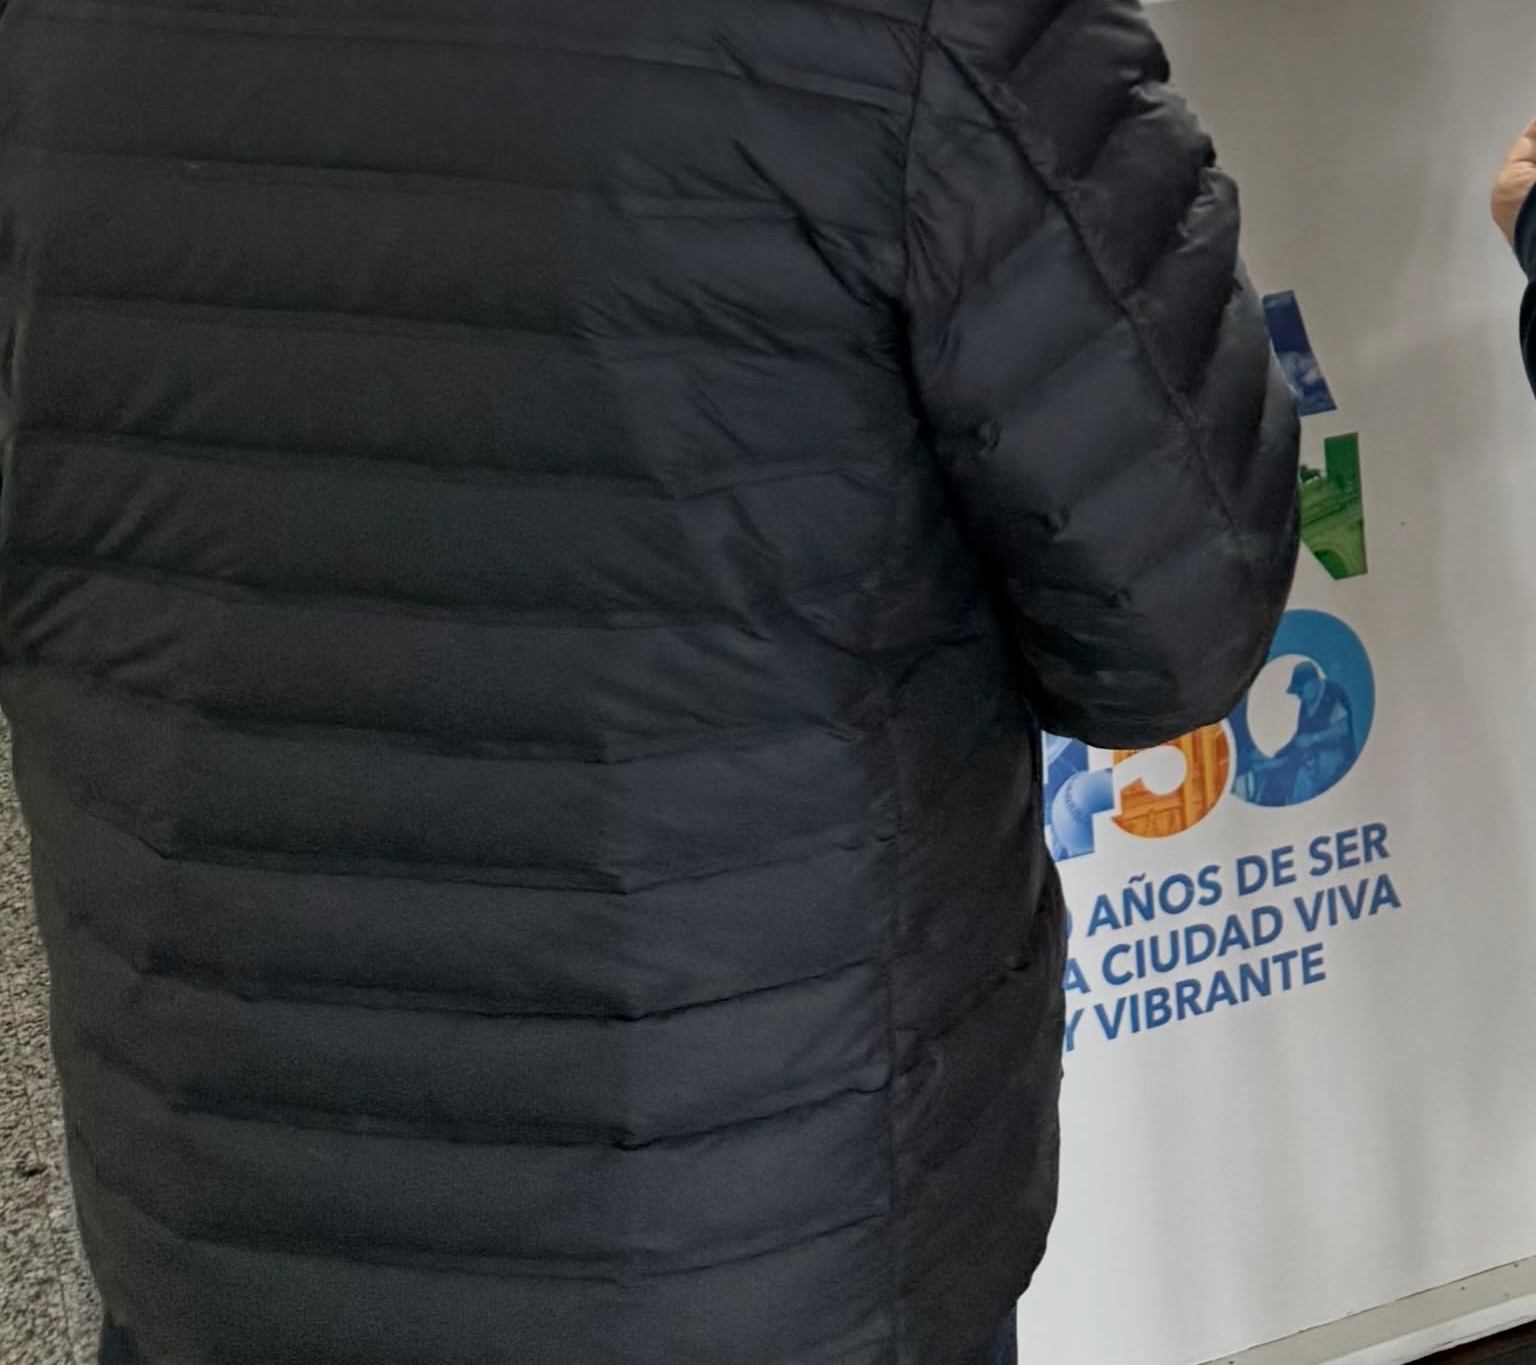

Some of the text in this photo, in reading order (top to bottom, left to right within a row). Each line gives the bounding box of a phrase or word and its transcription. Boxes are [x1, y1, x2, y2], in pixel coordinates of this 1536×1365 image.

[1086, 863, 1223, 937] AÑOS
[1236, 845, 1298, 897] DE
[1308, 822, 1391, 877] SER
[1101, 905, 1284, 986] CIUDAD
[1293, 873, 1403, 934] VIVA
[1094, 942, 1328, 1041] VIBRANTE
